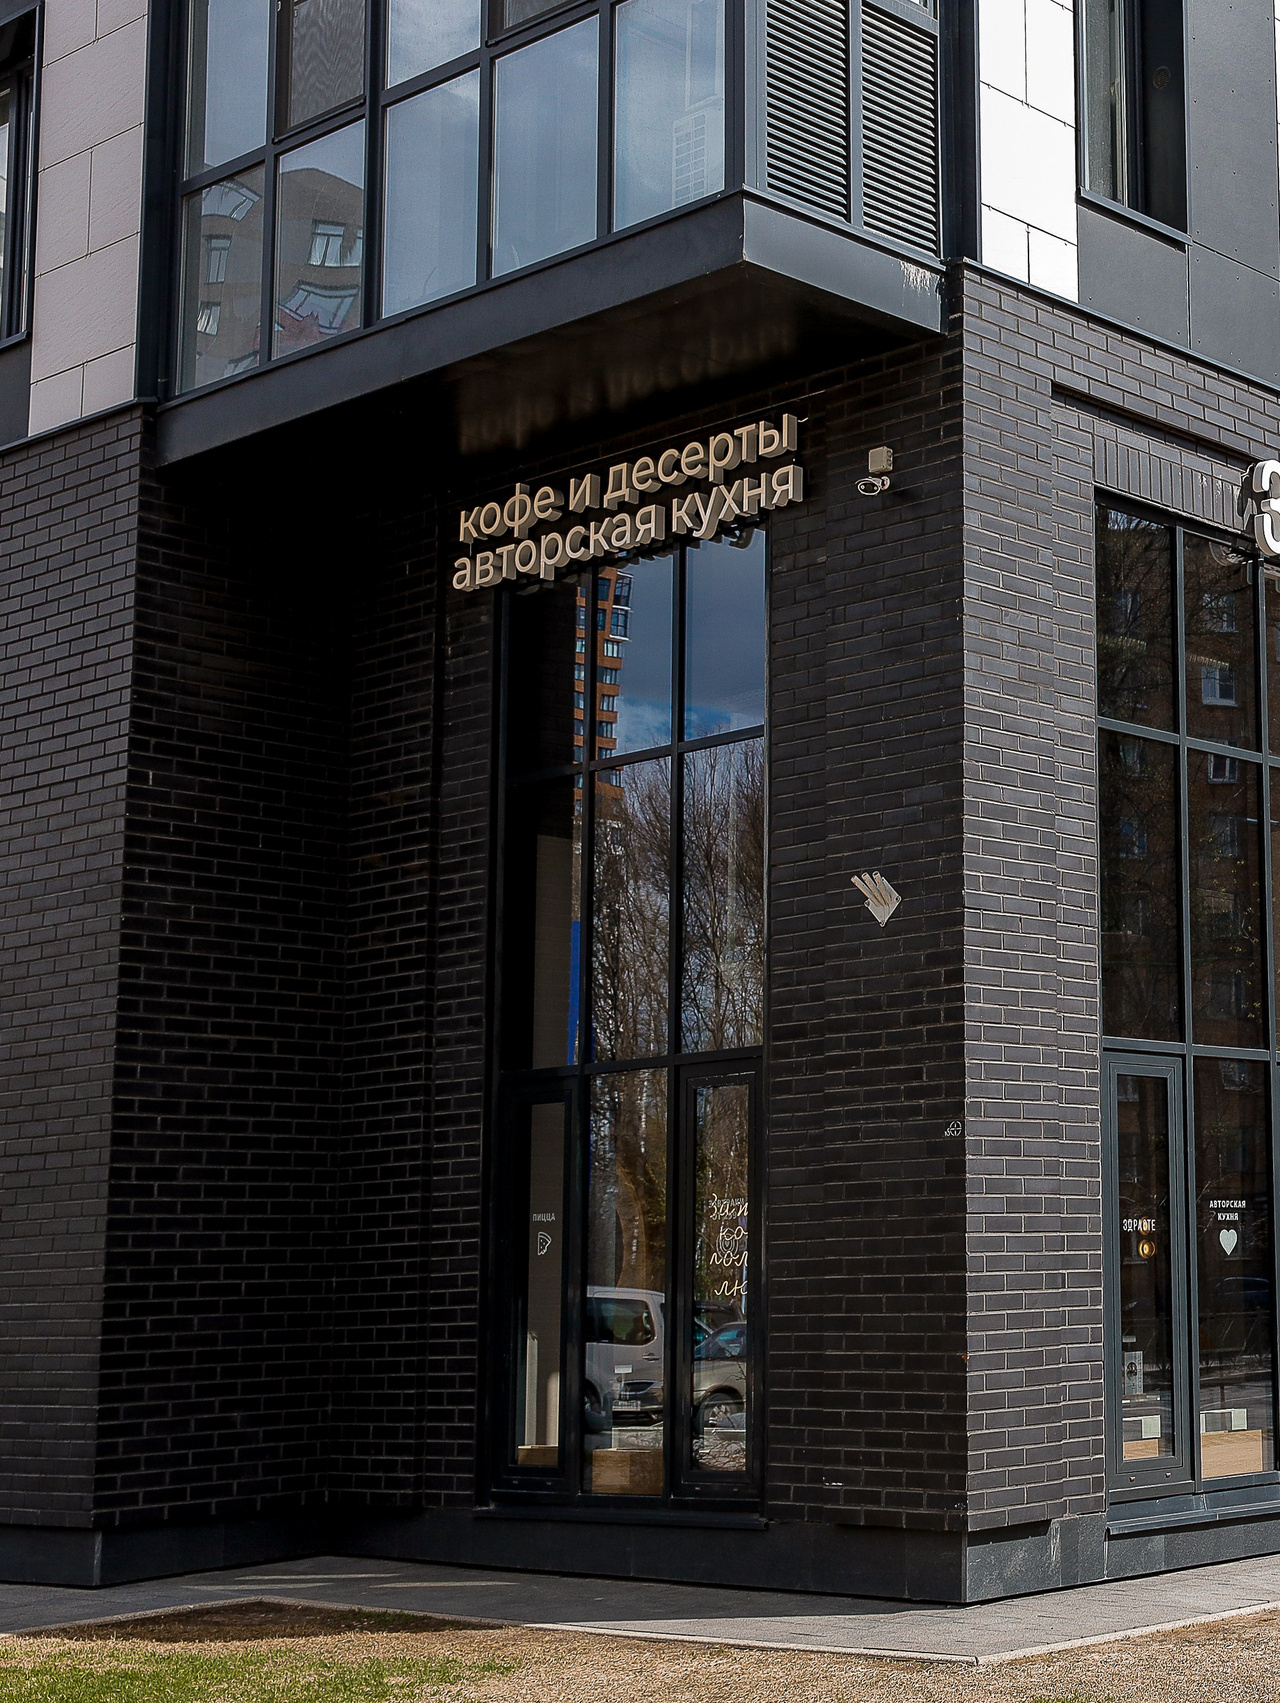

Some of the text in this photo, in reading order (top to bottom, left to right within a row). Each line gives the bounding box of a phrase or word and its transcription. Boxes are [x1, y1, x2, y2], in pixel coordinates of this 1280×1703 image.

[459, 413, 798, 543] кофе и десерты
[452, 464, 803, 591] авторская кухня
[1209, 1200, 1246, 1209] АВТОРСКАЯ
[532, 1212, 556, 1223] ПИЦЦА
[1217, 1213, 1239, 1221] КУХНЯ
[1122, 1218, 1156, 1232] ЗДРАСТЕ
